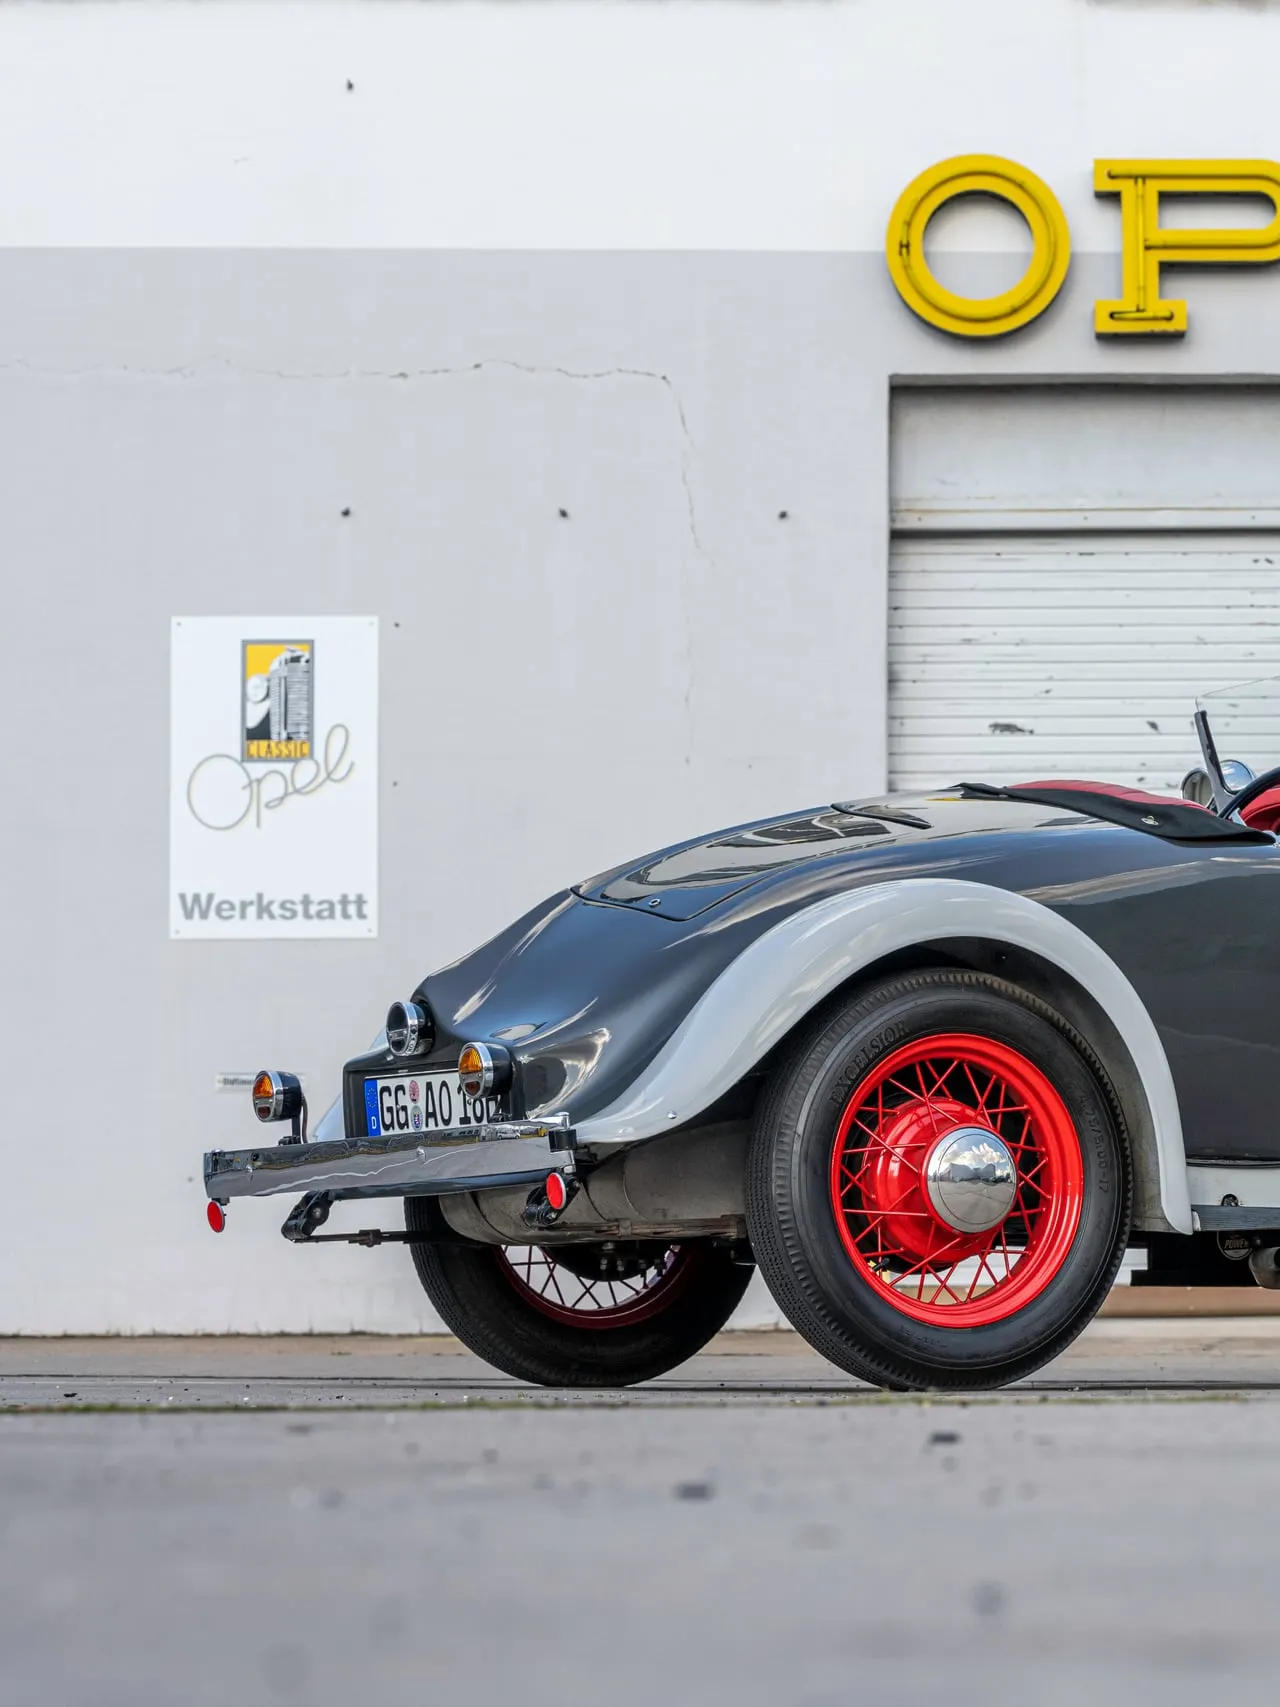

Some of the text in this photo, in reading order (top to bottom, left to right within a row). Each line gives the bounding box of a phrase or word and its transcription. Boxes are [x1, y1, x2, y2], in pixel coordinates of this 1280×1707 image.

[246, 740, 308, 758] CLASSIC
[187, 723, 354, 831] Opel
[178, 891, 369, 921] Werkstatt
[829, 1020, 909, 1107] EXCELSIOR
[370, 1116, 377, 1129] D
[379, 1084, 409, 1132] GG
[425, 1080, 452, 1128] AO
